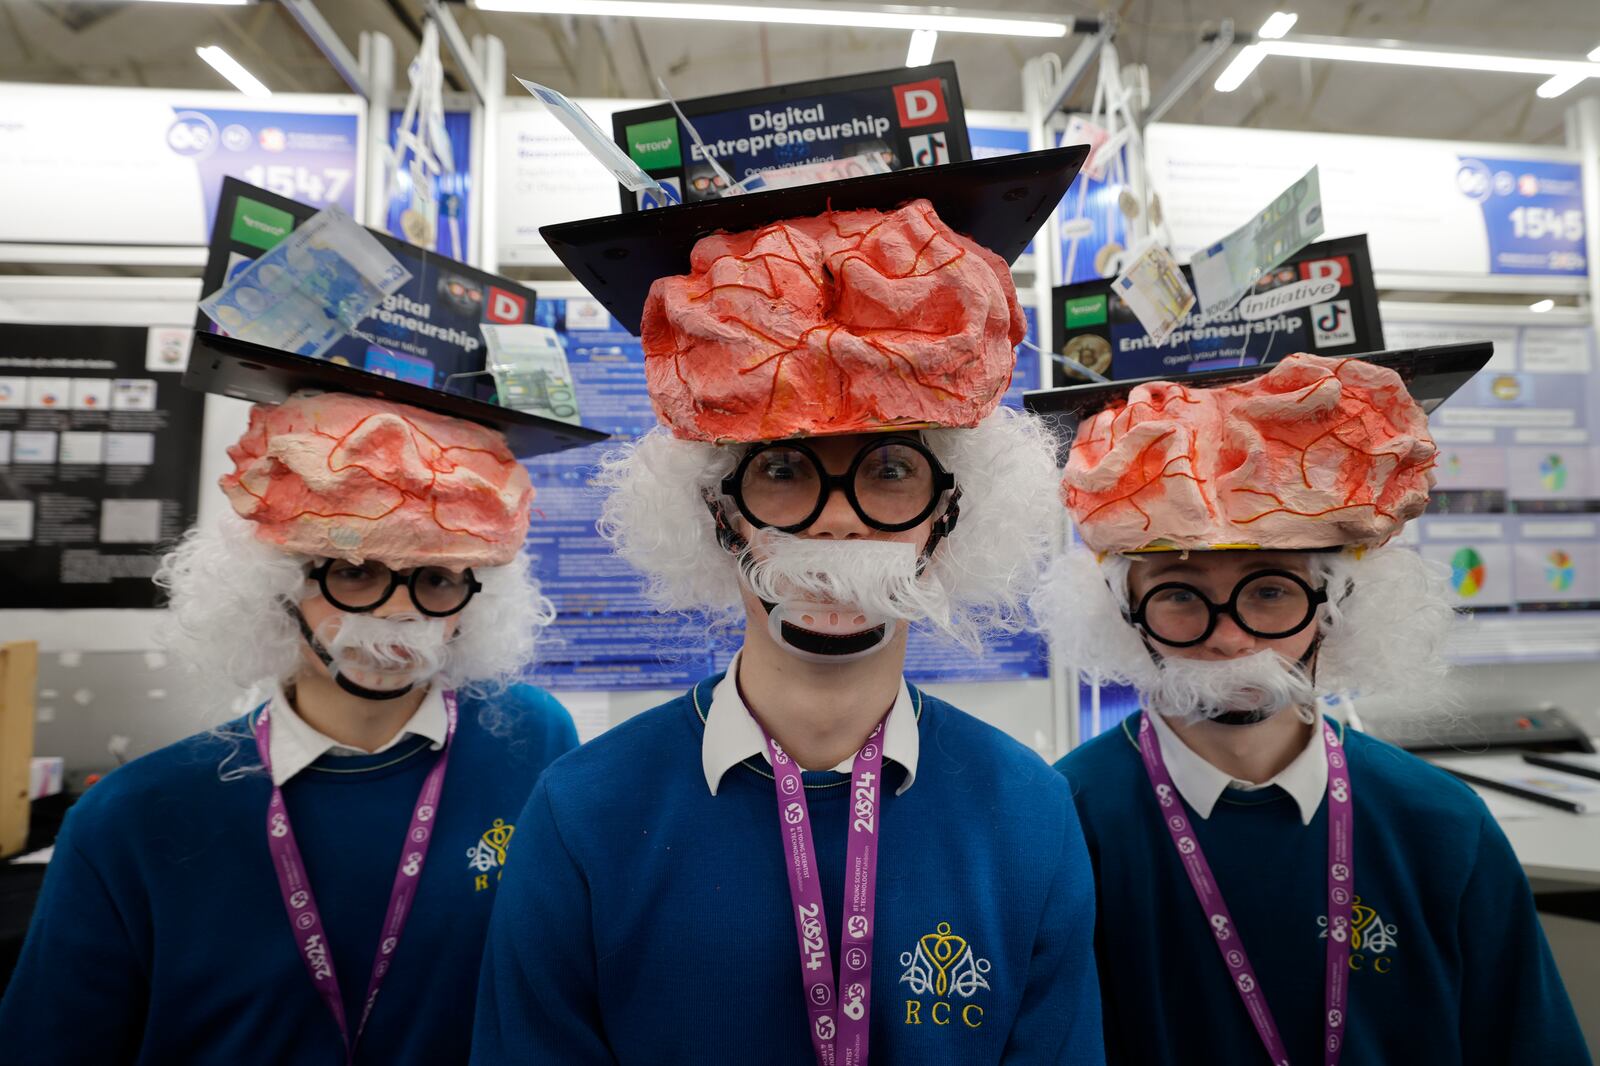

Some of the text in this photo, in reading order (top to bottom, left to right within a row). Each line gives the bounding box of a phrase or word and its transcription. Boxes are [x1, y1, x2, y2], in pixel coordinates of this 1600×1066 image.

[750, 104, 824, 132] Digital
[904, 89, 938, 119] D
[690, 116, 890, 161] Entrepreneurship
[244, 165, 351, 201] 1547
[1508, 206, 1584, 241] 1545
[494, 294, 520, 320] D
[369, 307, 480, 352] reneurship
[801, 853, 809, 878] SCIENTIST
[852, 952, 861, 965] BT
[815, 987, 825, 1001] BT
